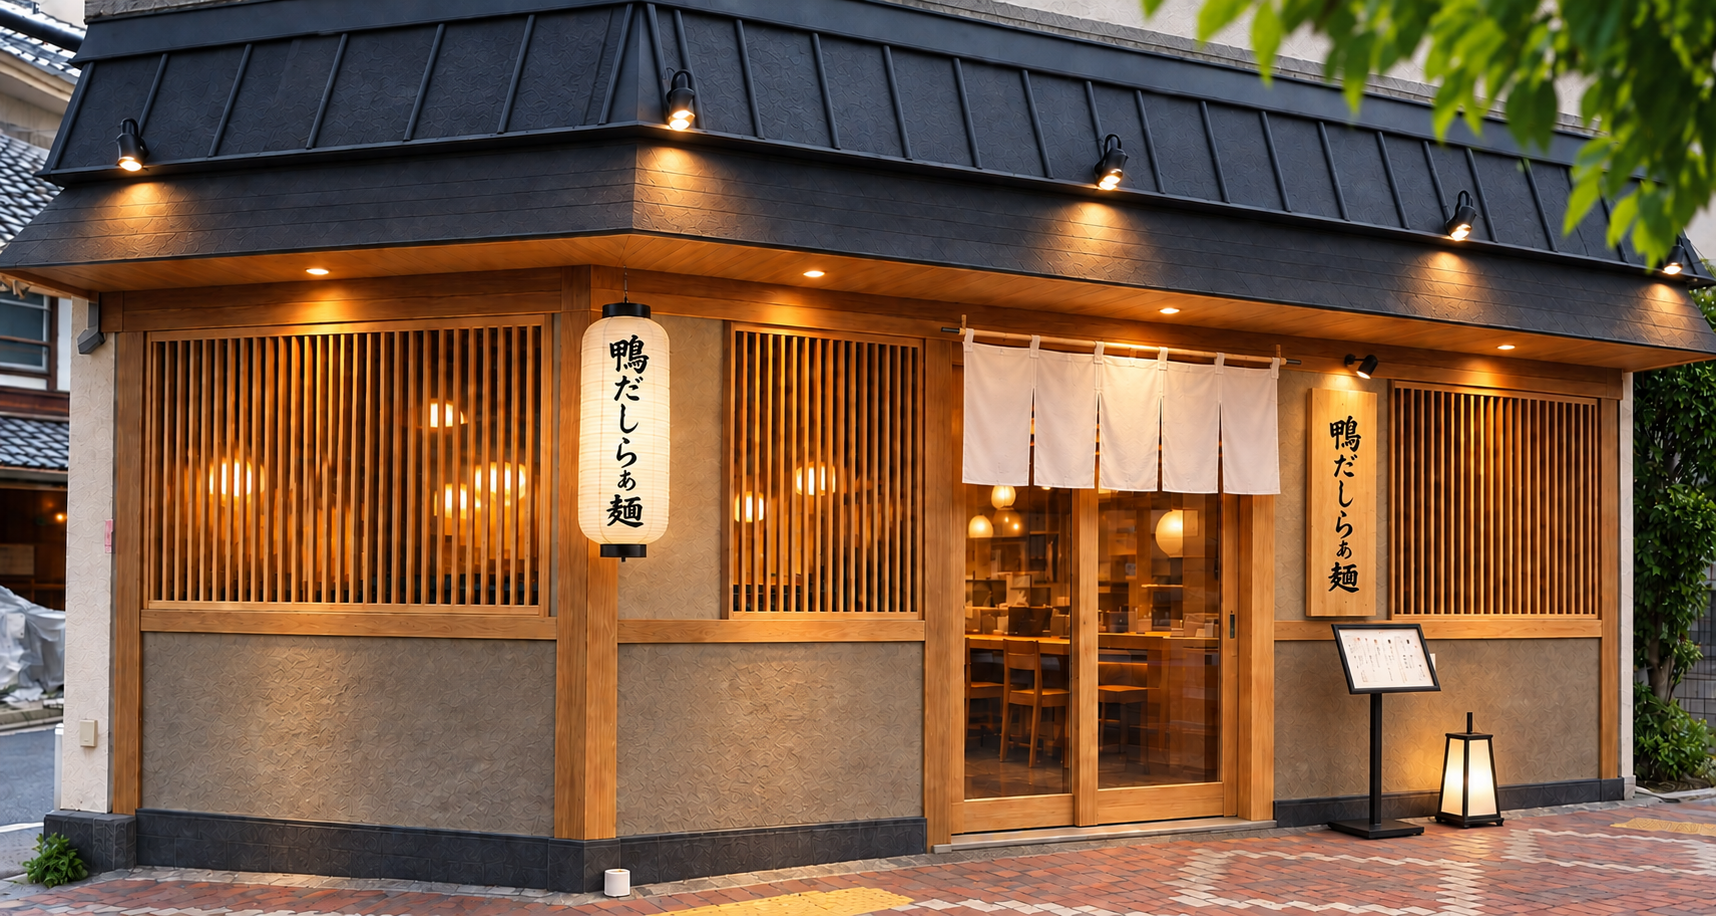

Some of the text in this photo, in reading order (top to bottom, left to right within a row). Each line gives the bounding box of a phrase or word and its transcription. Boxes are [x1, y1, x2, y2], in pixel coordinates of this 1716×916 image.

[606, 334, 650, 528] 鴨だしらぁ麺
[1327, 415, 1362, 594] 鴨だしらぁ麺
